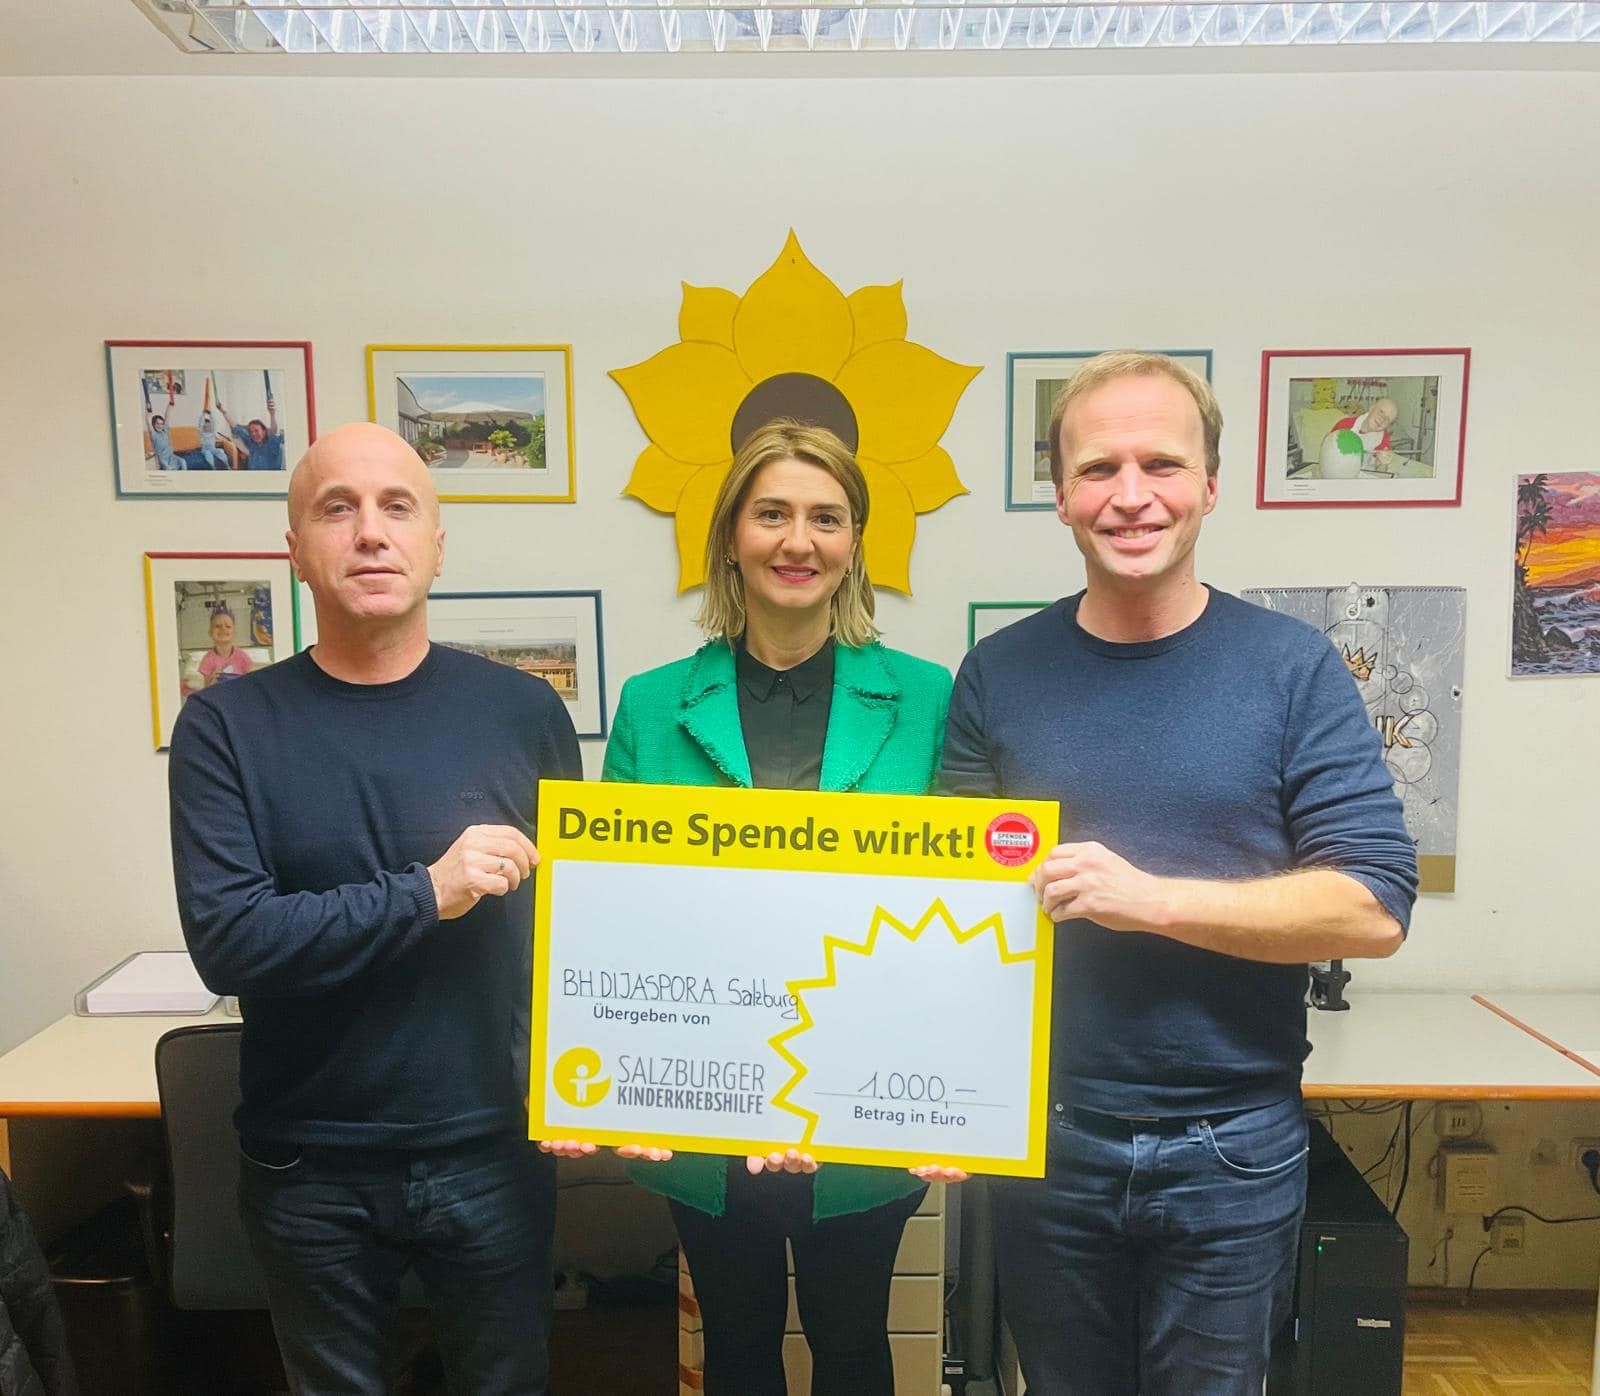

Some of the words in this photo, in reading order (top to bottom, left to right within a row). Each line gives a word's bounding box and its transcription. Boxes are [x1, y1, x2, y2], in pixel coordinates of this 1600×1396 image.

[558, 807, 673, 844] Deine
[686, 813, 840, 857] Spende
[853, 821, 976, 859] wirkt!
[600, 971, 716, 1004] DIJASPORA
[728, 977, 799, 1020] Salzburg
[593, 1003, 677, 1025] Übergeben
[682, 1012, 711, 1026] von
[617, 1054, 765, 1092] SALZBURGER
[617, 1085, 764, 1115] KINDERKREBSHILFE
[854, 1105, 905, 1125] Betrag
[911, 1109, 925, 1123] in
[931, 1111, 966, 1126] Euro
